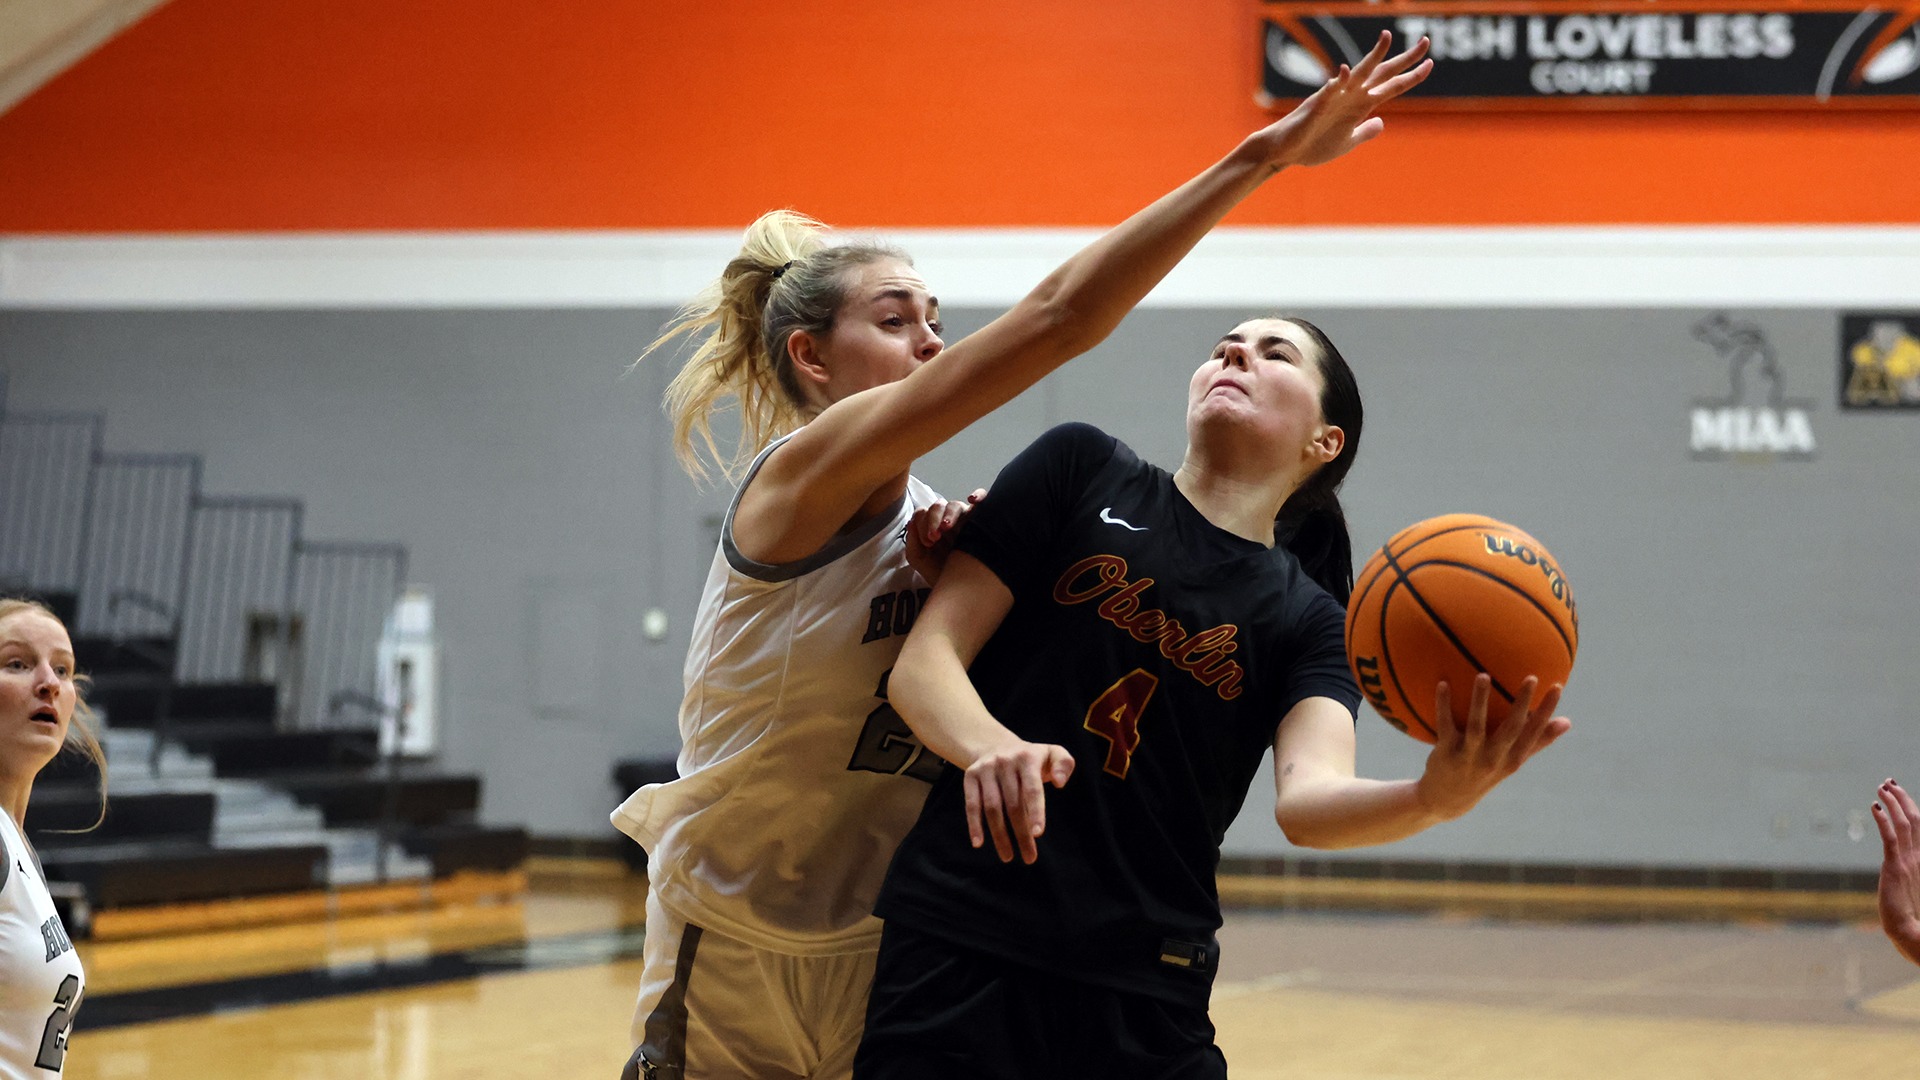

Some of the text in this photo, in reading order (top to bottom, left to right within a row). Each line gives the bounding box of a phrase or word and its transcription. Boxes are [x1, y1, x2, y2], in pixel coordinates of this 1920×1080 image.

[1398, 14, 1796, 59] TISH LOVELESS
[1530, 60, 1655, 93] COURT
[1690, 408, 1815, 451] MIAA
[1053, 554, 1244, 700] Oberlin
[1083, 667, 1159, 780] 4
[40, 914, 73, 963] HO
